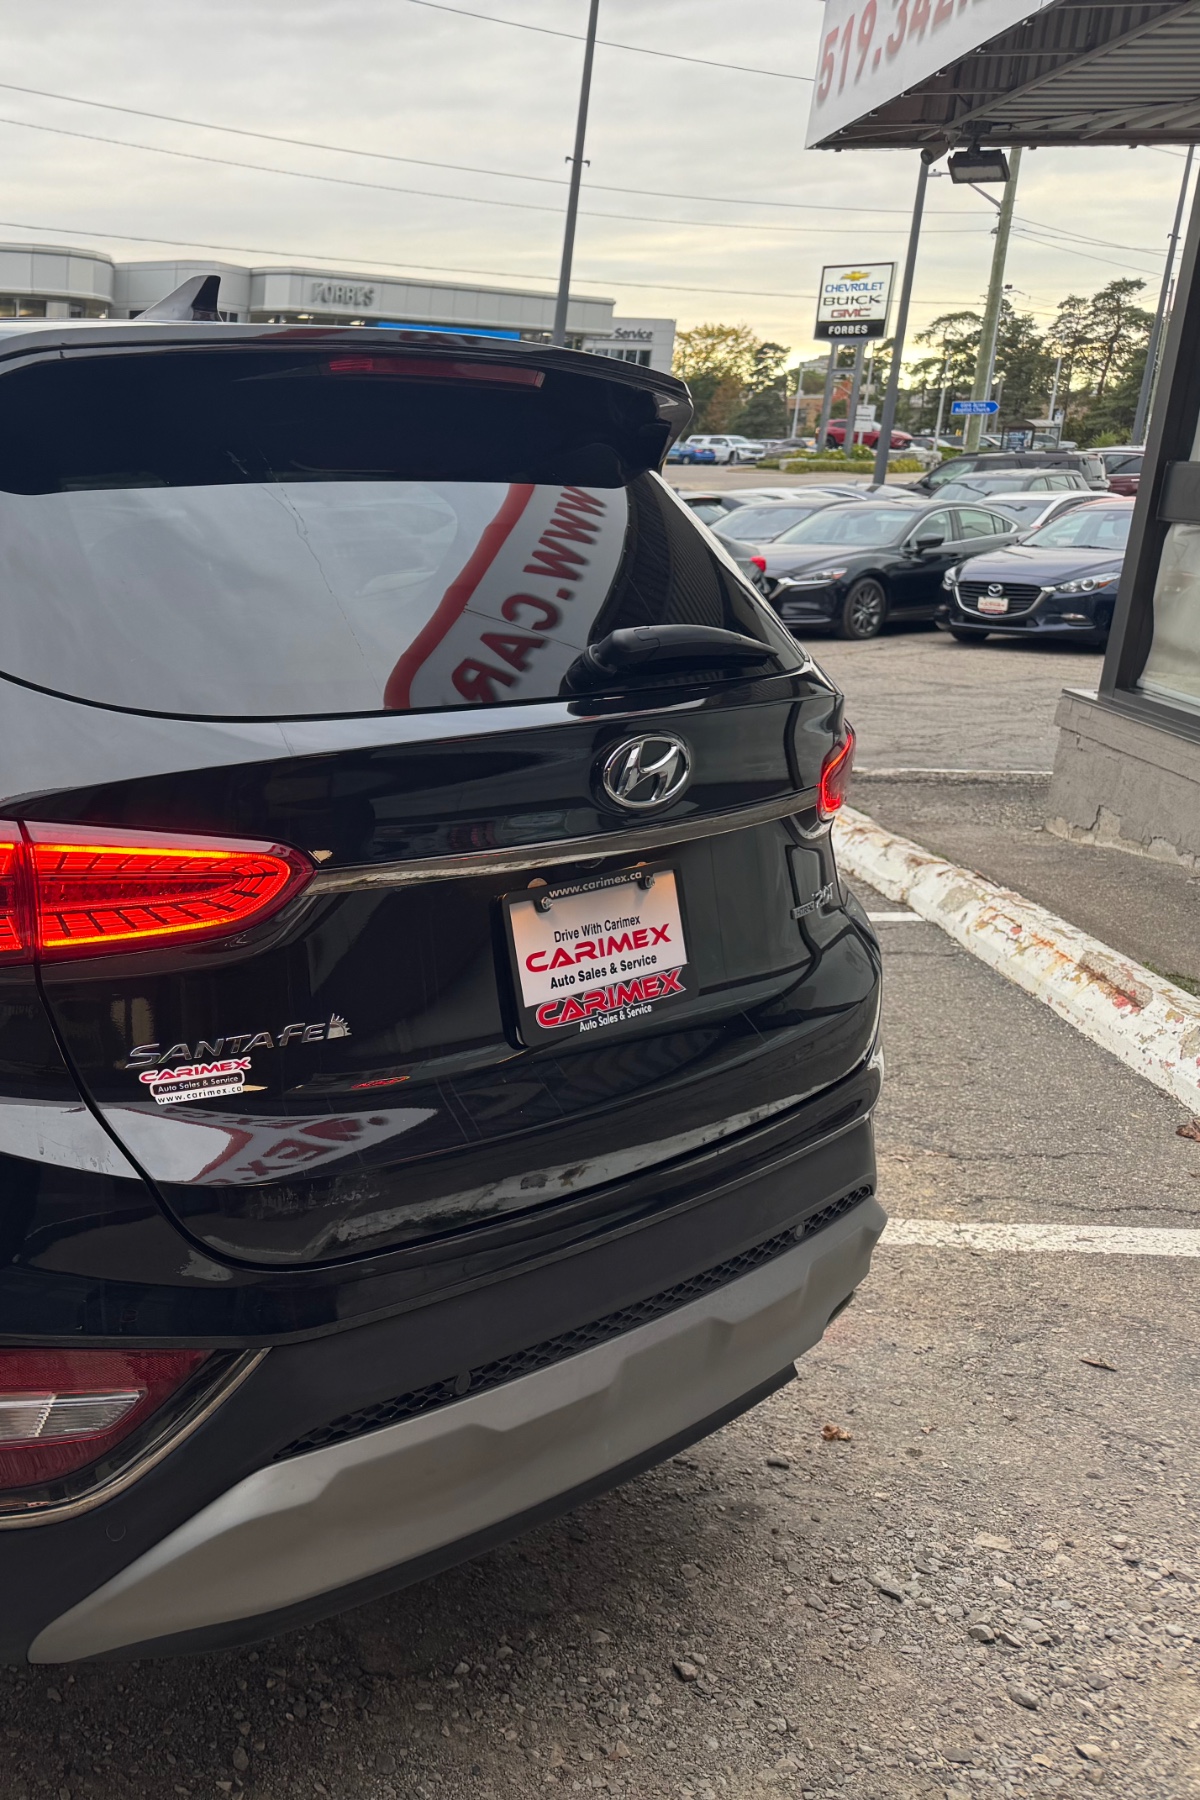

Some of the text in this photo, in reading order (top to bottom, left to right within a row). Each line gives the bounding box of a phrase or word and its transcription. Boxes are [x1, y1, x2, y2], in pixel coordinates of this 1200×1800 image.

[311, 283, 375, 306] FORBES
[825, 282, 884, 293] CHEVROLET
[823, 295, 882, 306] BUICK
[830, 308, 871, 318] GMC
[614, 328, 653, 339] Service
[828, 325, 868, 335] FORBES
[549, 871, 642, 898] www.carimex.ca
[554, 915, 641, 943] Drive With Carimex
[525, 923, 672, 973] CARIMEX
[550, 953, 657, 989] Auto Sales & Service
[536, 968, 685, 1027] CARIMEX
[579, 1003, 652, 1032] Auto Sales & Service
[125, 1022, 326, 1069] SANTA FE
[140, 1058, 251, 1082] CARIMEX
[158, 1086, 242, 1103] www.carimex.ca
[179, 1082, 200, 1090] Sales
[211, 1076, 238, 1085] Service
